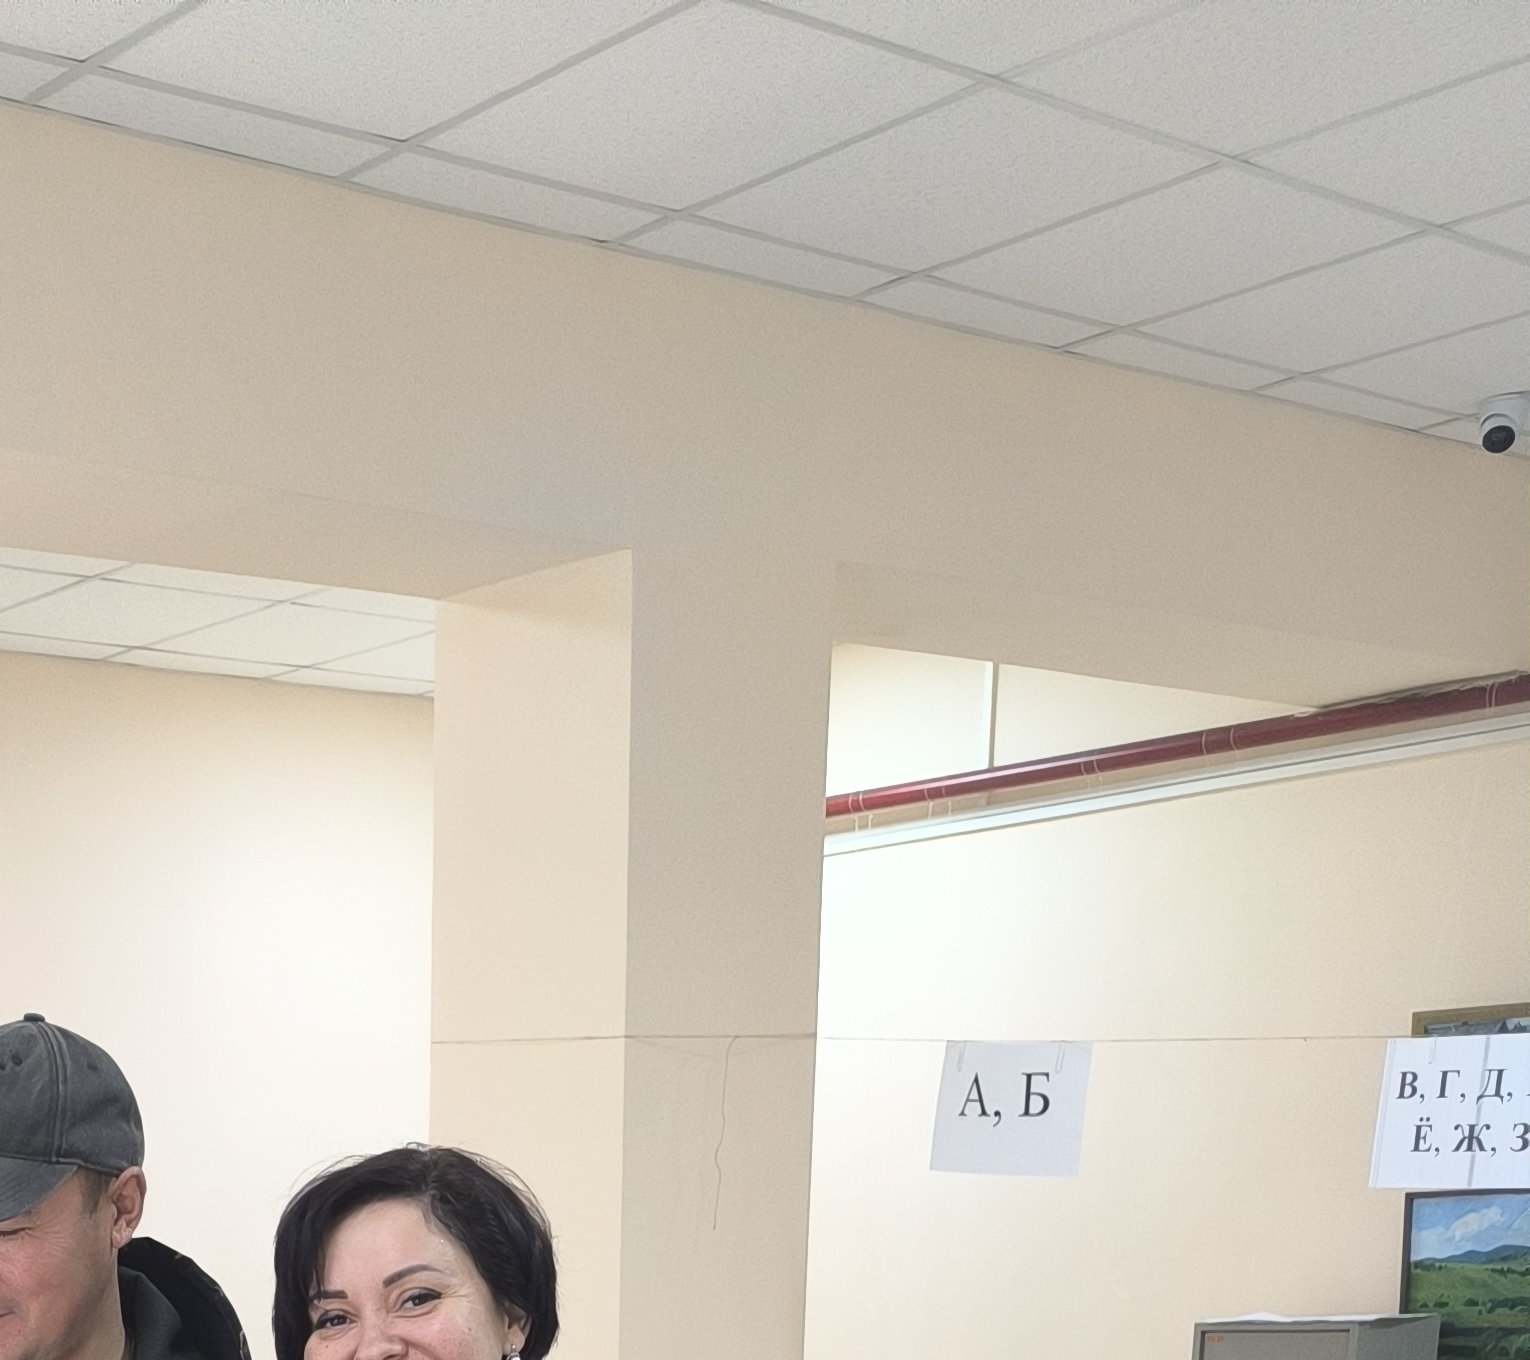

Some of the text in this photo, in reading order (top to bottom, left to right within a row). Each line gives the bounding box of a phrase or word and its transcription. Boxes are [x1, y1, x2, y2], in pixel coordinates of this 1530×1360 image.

[957, 1071, 1050, 1128] А, Б
[1395, 1070, 1425, 1104] В,
[1436, 1069, 1466, 1103] Г,
[1475, 1068, 1513, 1105] Д,
[1410, 1116, 1440, 1158] Ё,
[1451, 1123, 1497, 1157] Ж,
